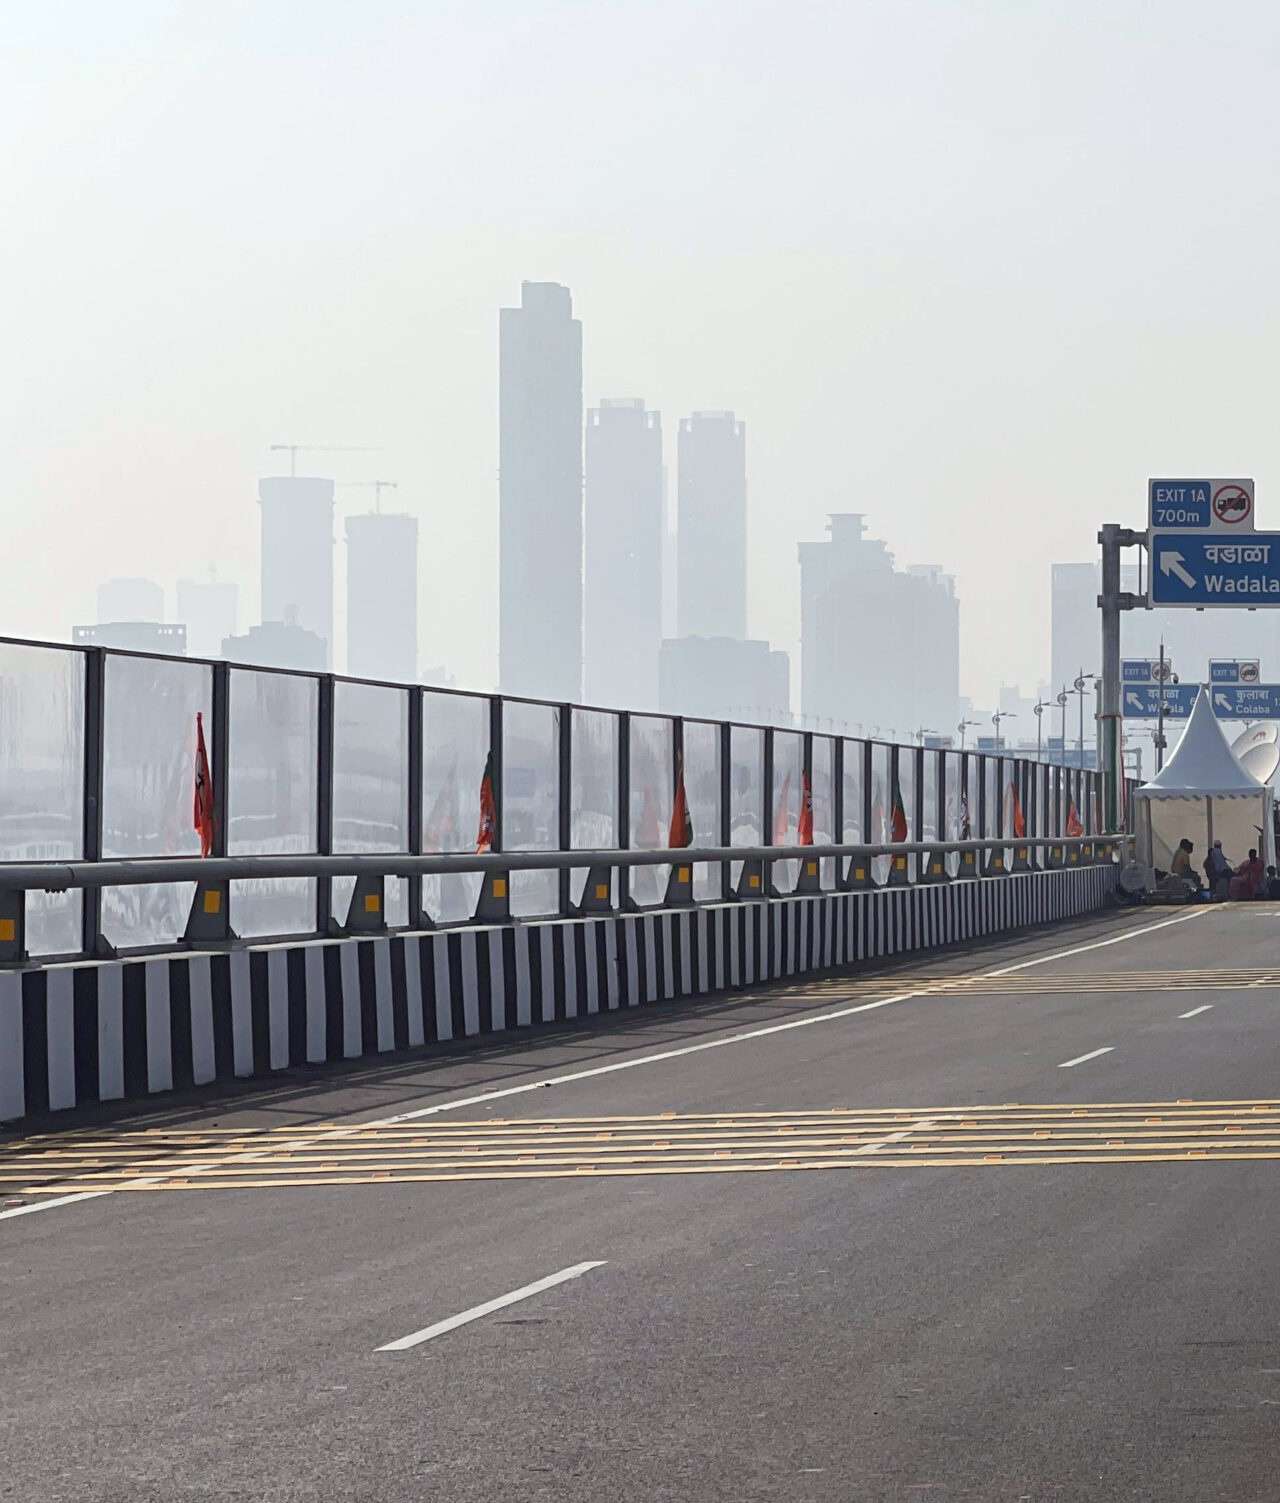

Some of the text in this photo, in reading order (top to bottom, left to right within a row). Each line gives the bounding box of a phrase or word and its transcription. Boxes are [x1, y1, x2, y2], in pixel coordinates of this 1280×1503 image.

[1156, 489, 1206, 502] EXIT 1A
[1156, 509, 1200, 523] 700m
[1203, 544, 1271, 564] वडाळा
[1204, 575, 1280, 593] Wadala
[1235, 690, 1270, 704] कुलाबा
[1147, 704, 1184, 713] Wala
[1235, 704, 1270, 714] Colaba
